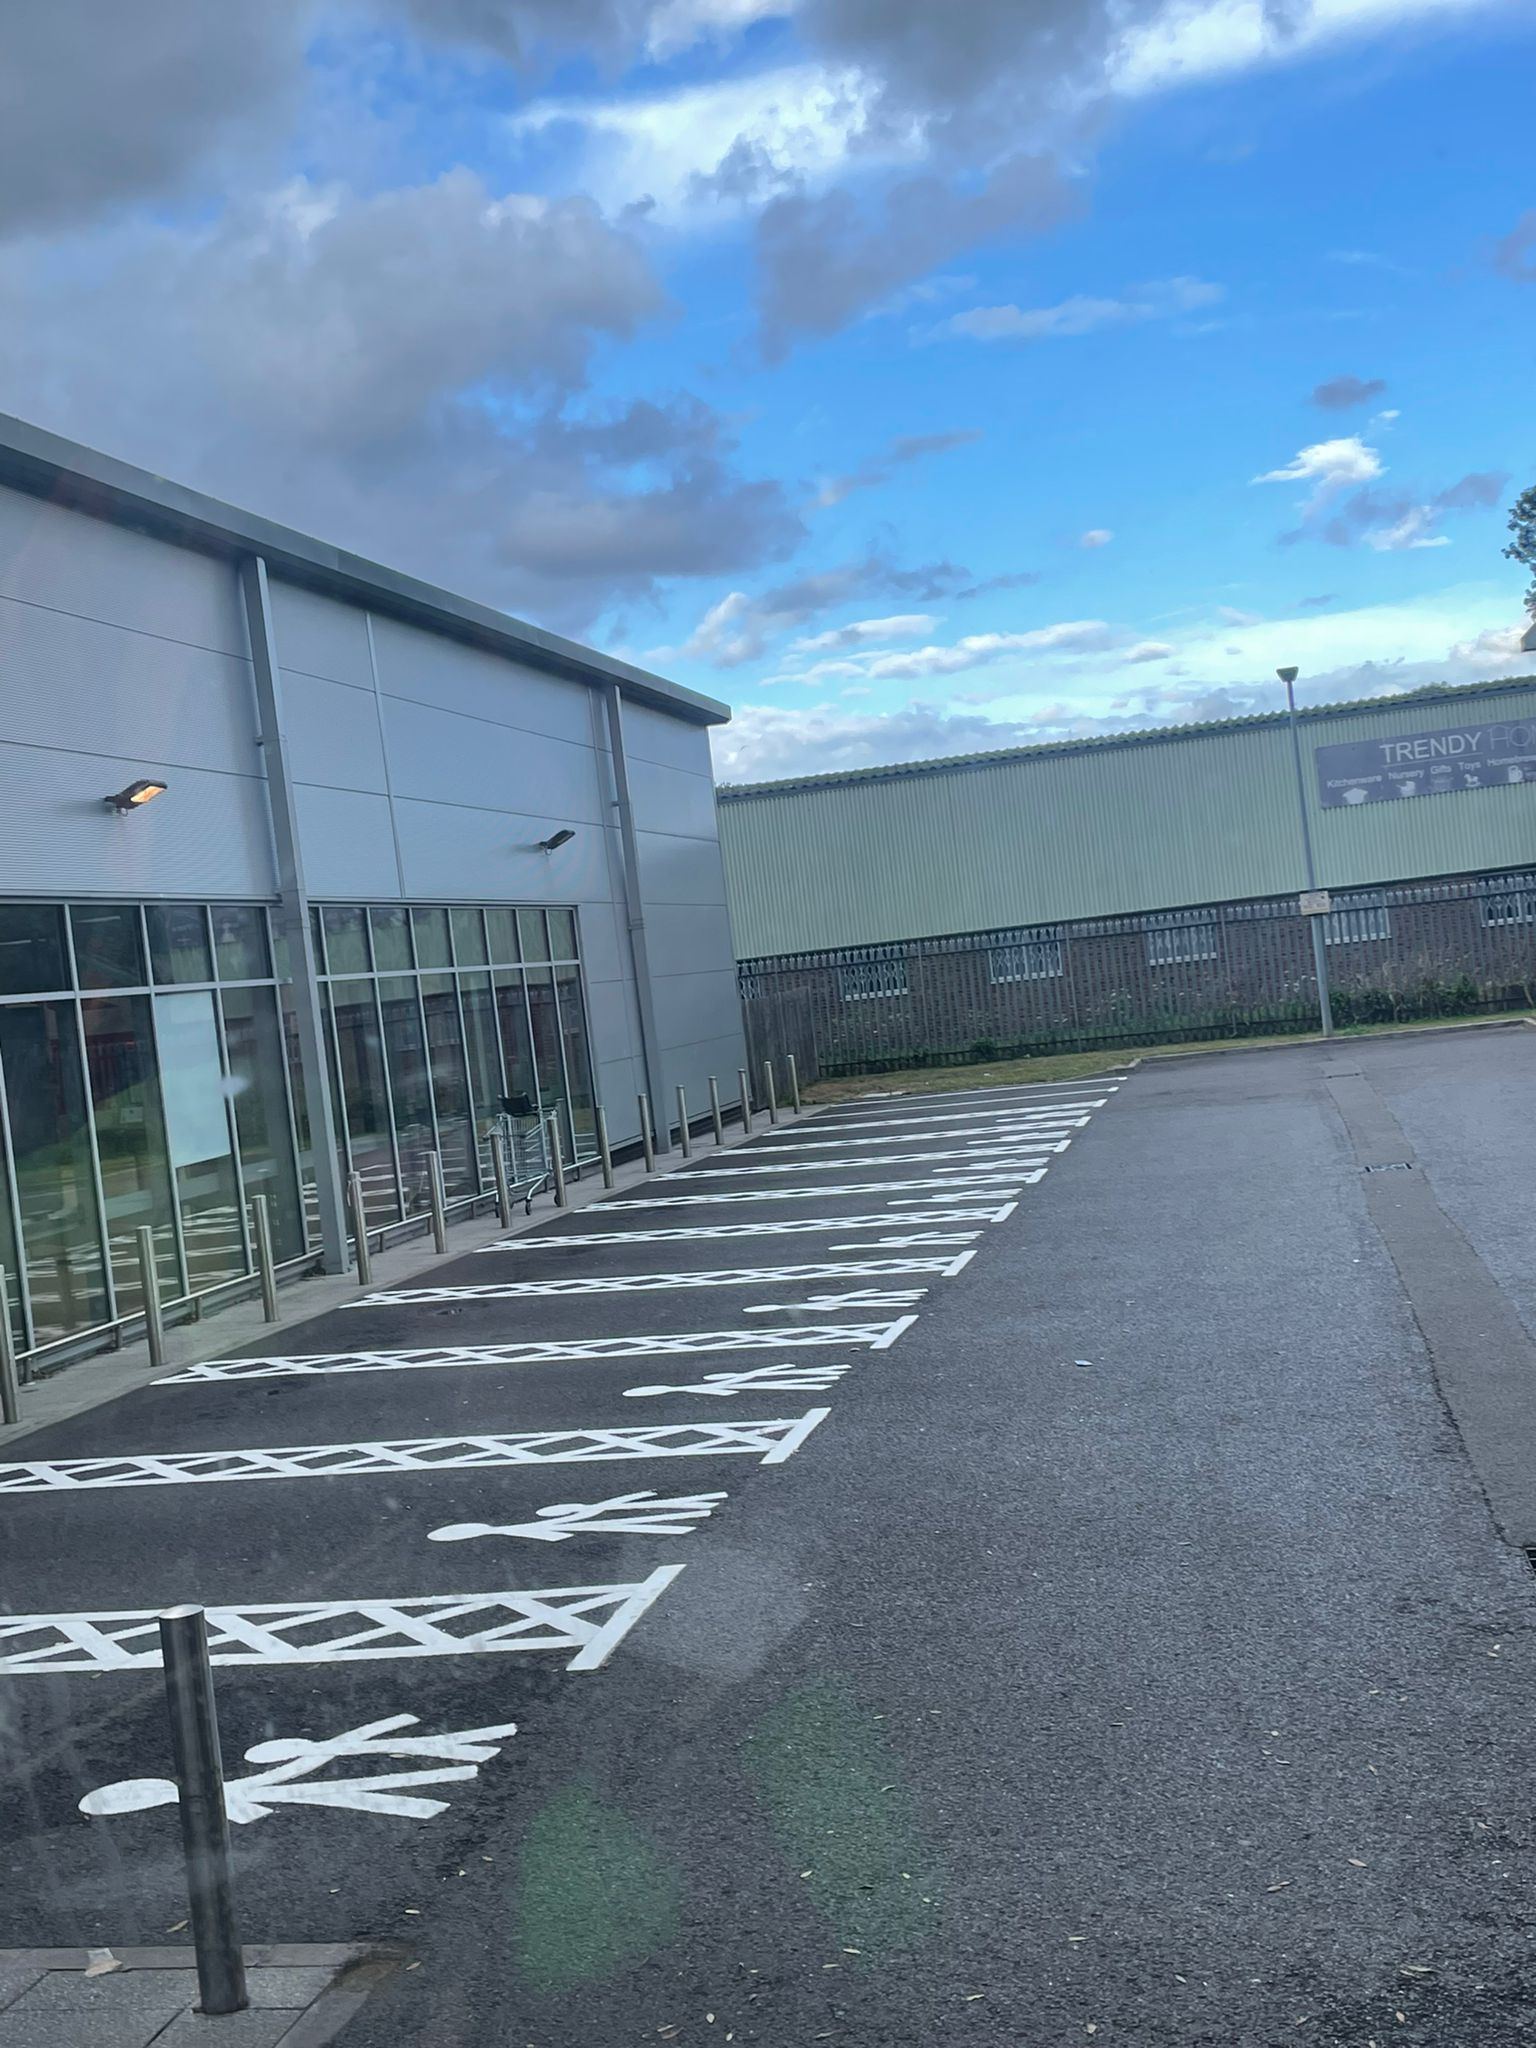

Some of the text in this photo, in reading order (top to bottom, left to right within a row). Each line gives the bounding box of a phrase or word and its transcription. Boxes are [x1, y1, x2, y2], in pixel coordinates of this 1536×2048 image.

[1379, 732, 1482, 763] TRENDY
[1388, 769, 1424, 780] Nursery
[1458, 762, 1481, 771] Toys
